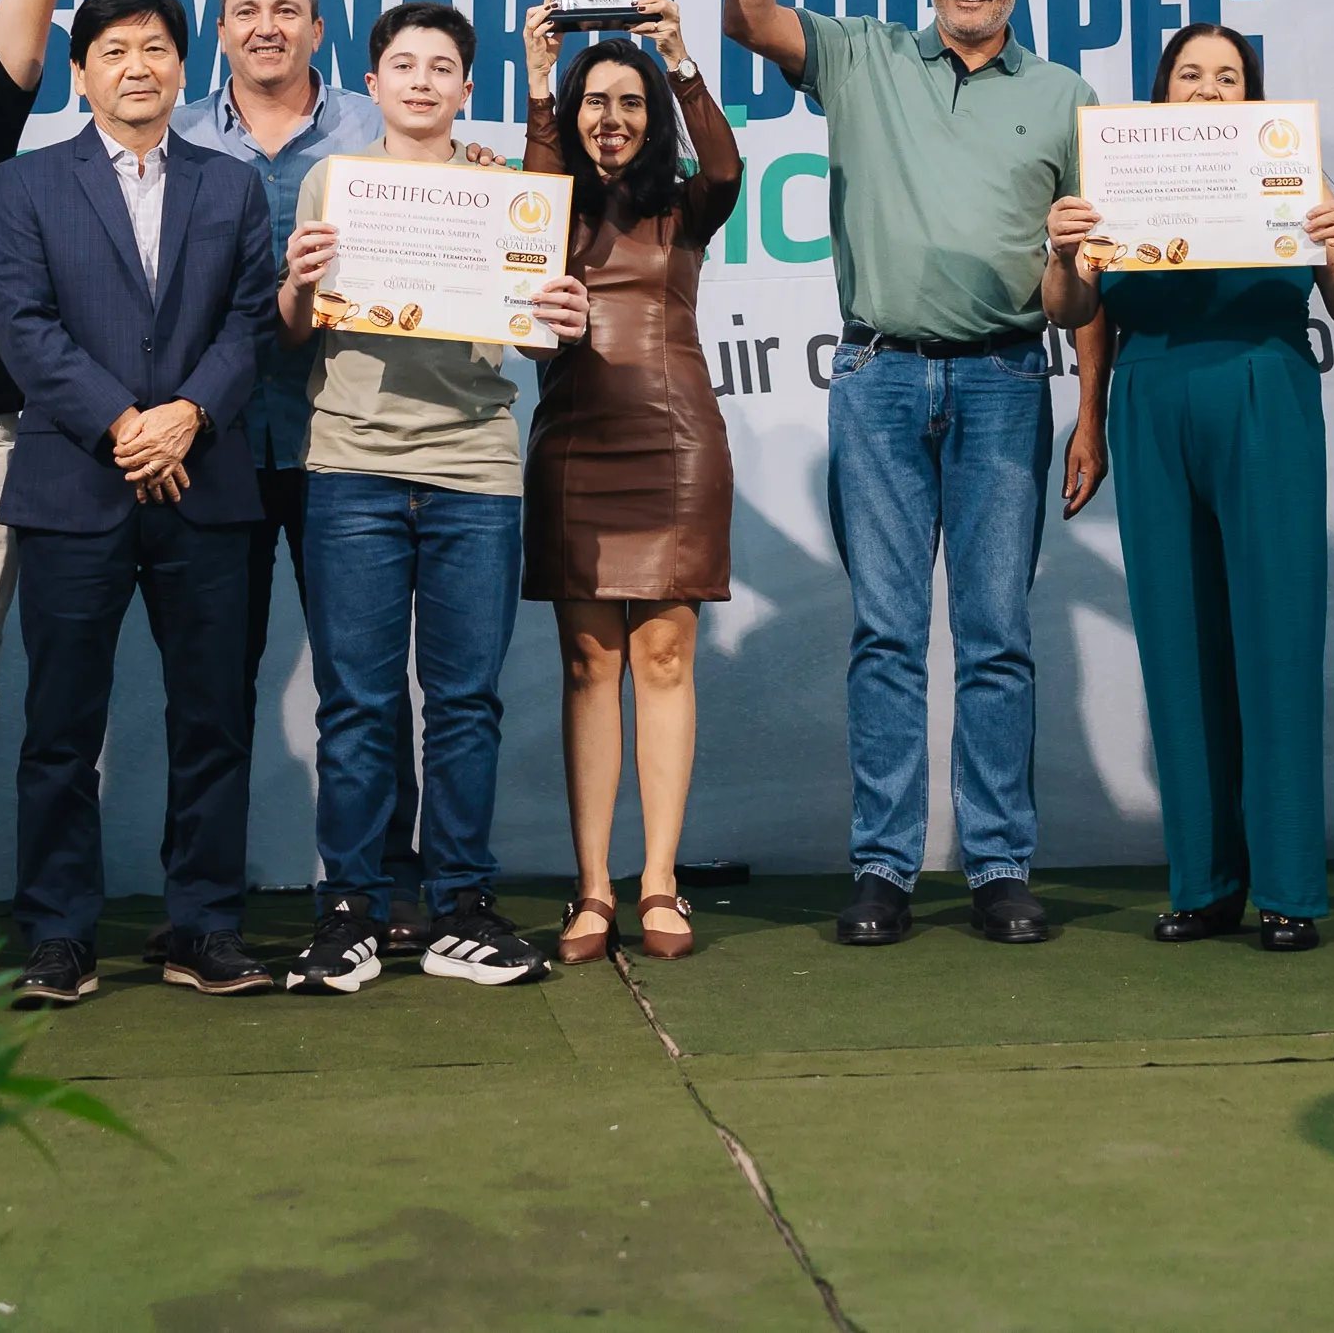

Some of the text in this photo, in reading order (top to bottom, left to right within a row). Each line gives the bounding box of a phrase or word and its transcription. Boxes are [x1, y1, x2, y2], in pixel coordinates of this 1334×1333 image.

[1101, 125, 1238, 144] CERTIFICADO
[1180, 165, 1192, 173] DE
[1250, 166, 1312, 177] QUALIDADE
[1275, 178, 1301, 186] 2025
[348, 179, 490, 209] CERTIFICADO
[1113, 187, 1153, 195] COLOCAÇÃO
[1147, 217, 1199, 227] QUALIDADE
[349, 220, 394, 232] FERNANDO
[395, 225, 406, 233] DE
[408, 225, 445, 237] OLIVEIRA
[504, 233, 547, 244] CONCURSO
[495, 238, 558, 254] QUALIDADE
[346, 246, 389, 254] COLOCAÇÃO
[400, 250, 437, 258] CATEGORIA
[443, 253, 488, 263] FERMENTADO
[520, 255, 545, 264] 2025
[384, 279, 436, 292] QUALIDADE
